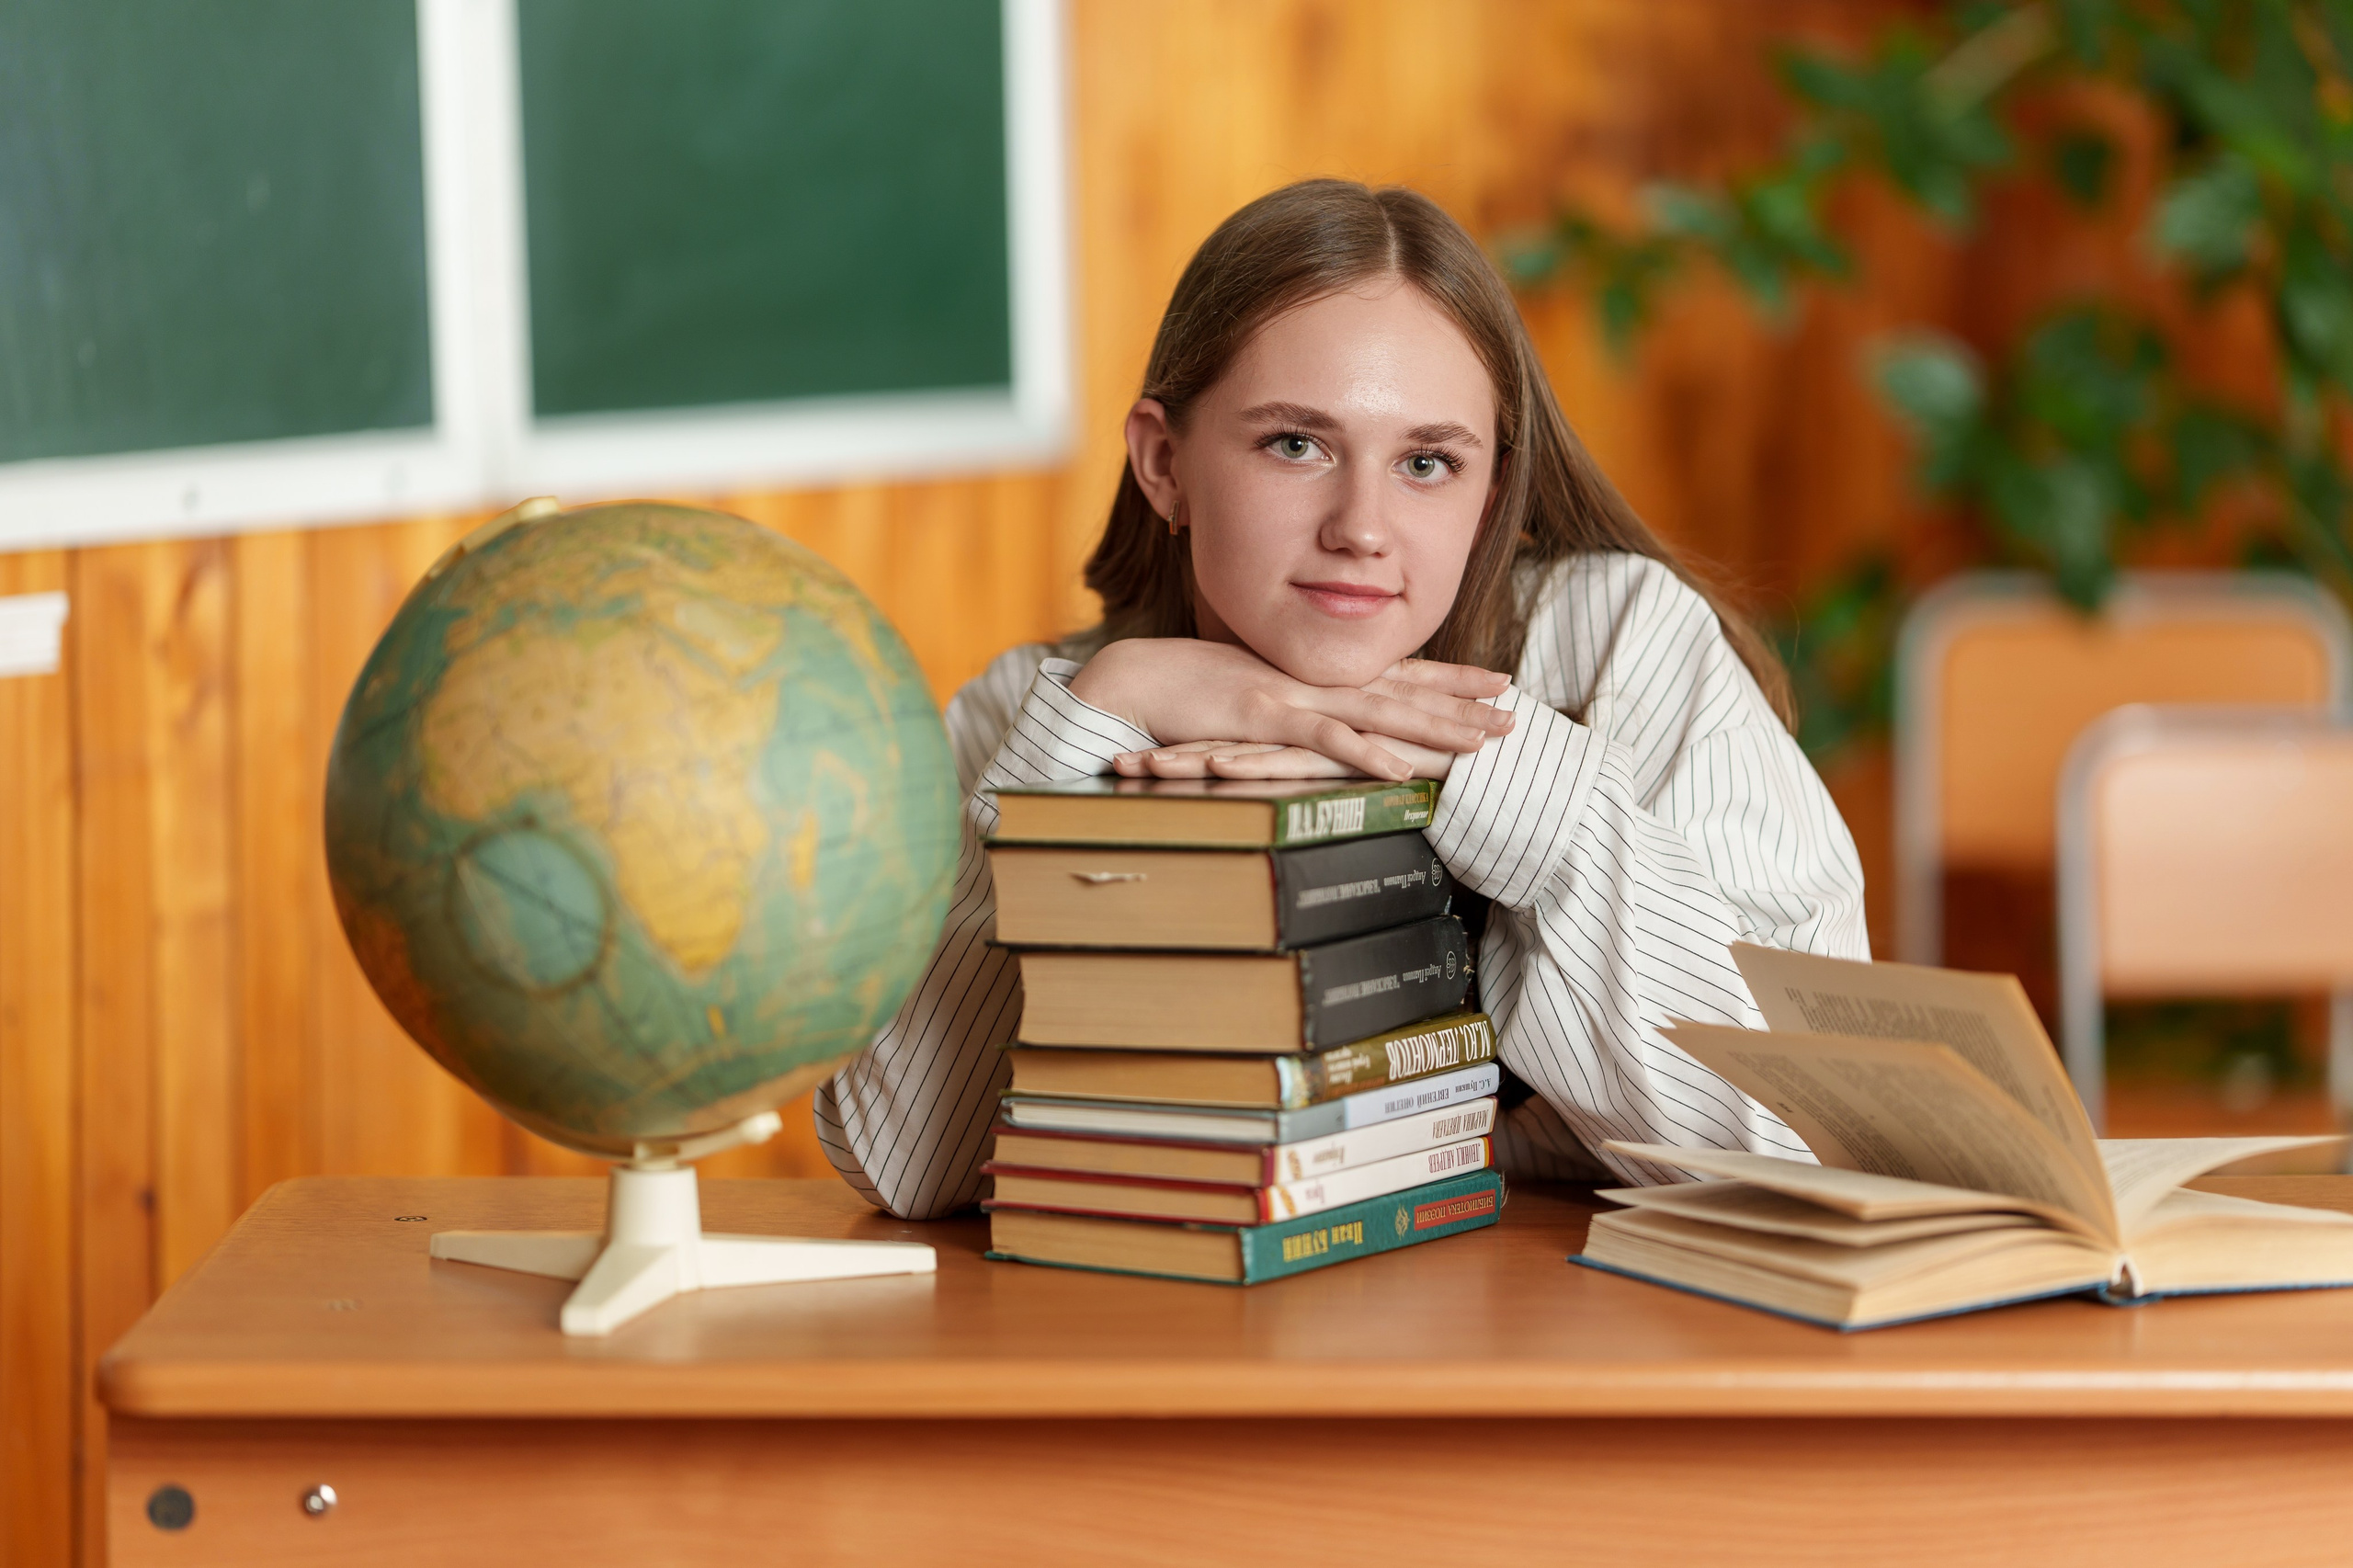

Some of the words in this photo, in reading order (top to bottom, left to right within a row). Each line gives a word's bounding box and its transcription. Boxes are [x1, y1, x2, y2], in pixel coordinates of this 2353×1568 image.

[1407, 869, 1426, 887] Андрей
[1425, 963, 1442, 981] Андрей
[1384, 1096, 1414, 1113] ОНЕГИН
[1417, 1088, 1449, 1108] ЕВГЕНИЙ
[1432, 1113, 1461, 1139] ЦВЕТАЕВА
[1462, 1109, 1489, 1132] МАРИНА
[1427, 1149, 1454, 1173] АНДРЕЕВ
[1455, 1143, 1481, 1167] ЛЕОНИД
[1416, 1206, 1446, 1224] ПОЭЗИИ
[1449, 1196, 1494, 1216] БИБЛИОТЕКА
[1331, 1221, 1363, 1245] Иван
[1282, 1228, 1328, 1262] БУНИН
